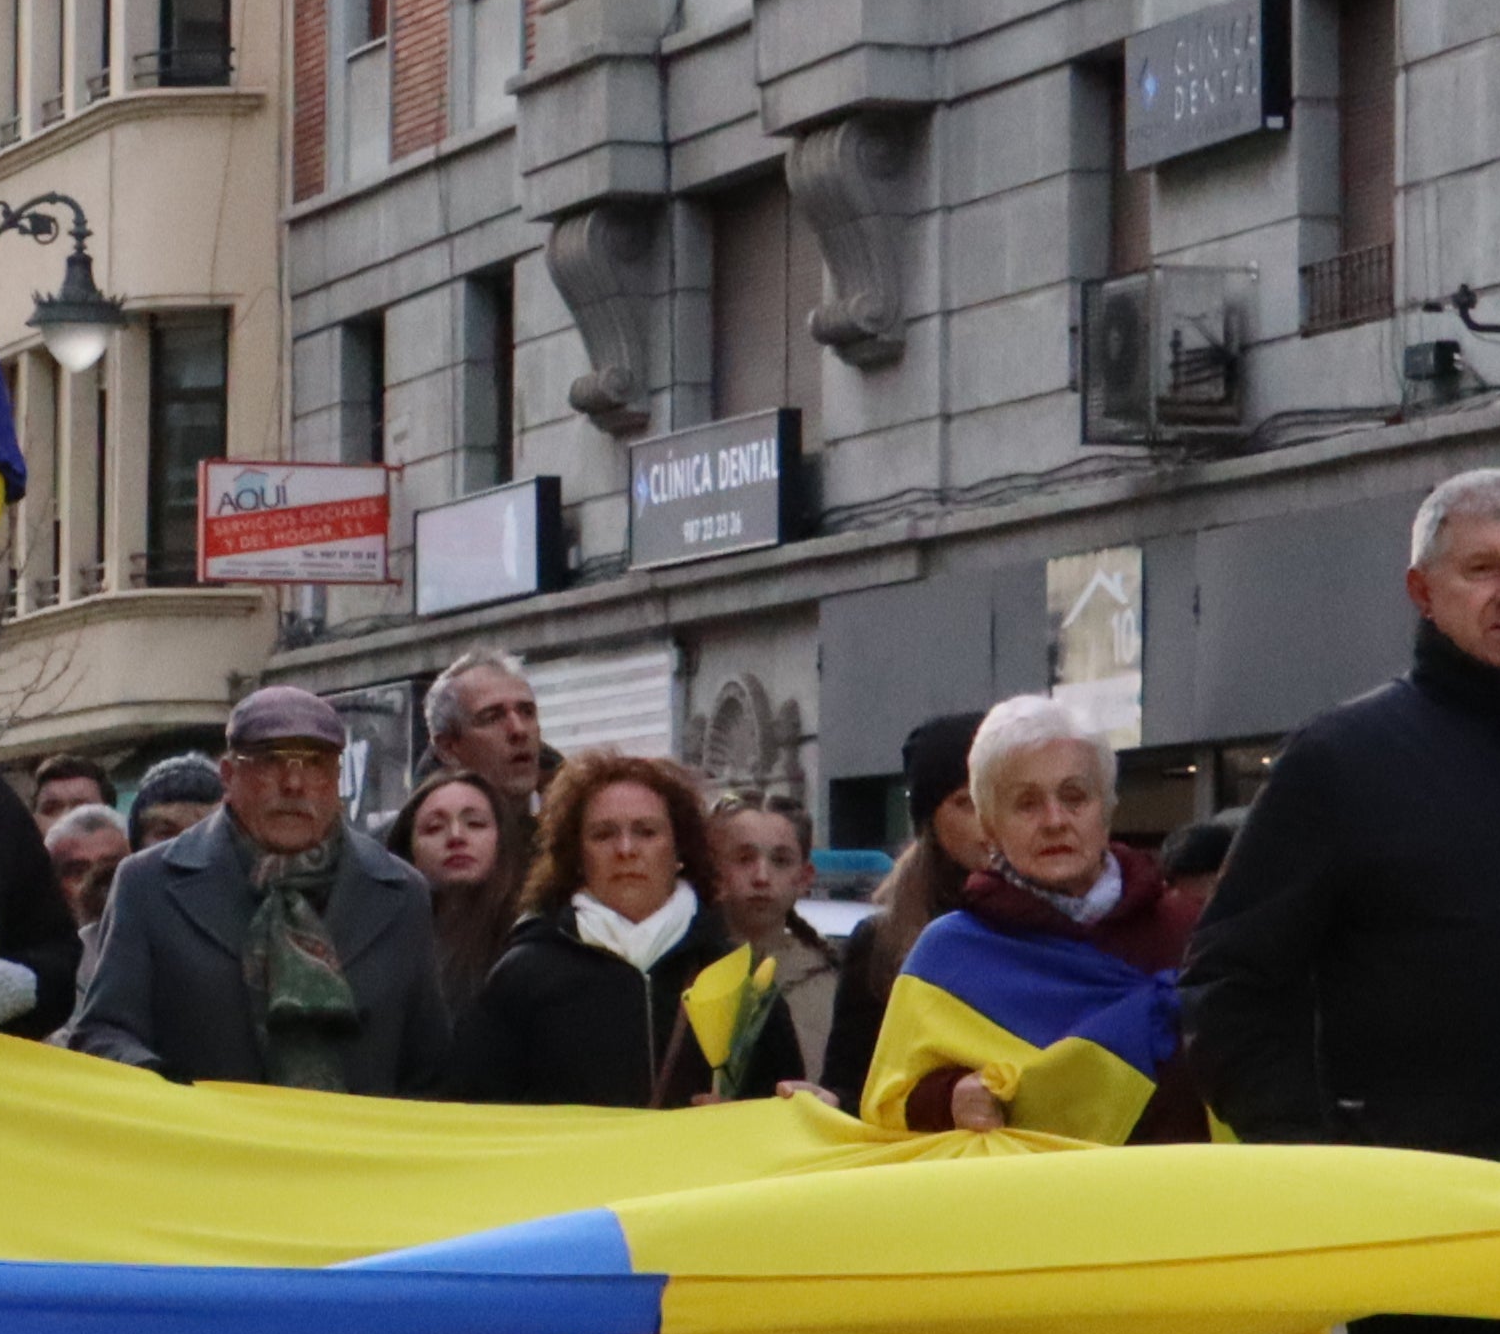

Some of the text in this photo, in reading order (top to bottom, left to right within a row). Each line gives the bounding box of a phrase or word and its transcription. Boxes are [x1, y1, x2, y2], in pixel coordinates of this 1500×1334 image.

[651, 438, 778, 505] CLÍNICA DENTAL
[213, 500, 380, 535] SERVICIOS SOCIALES
[224, 539, 234, 551] Y
[239, 535, 267, 550] DEL
